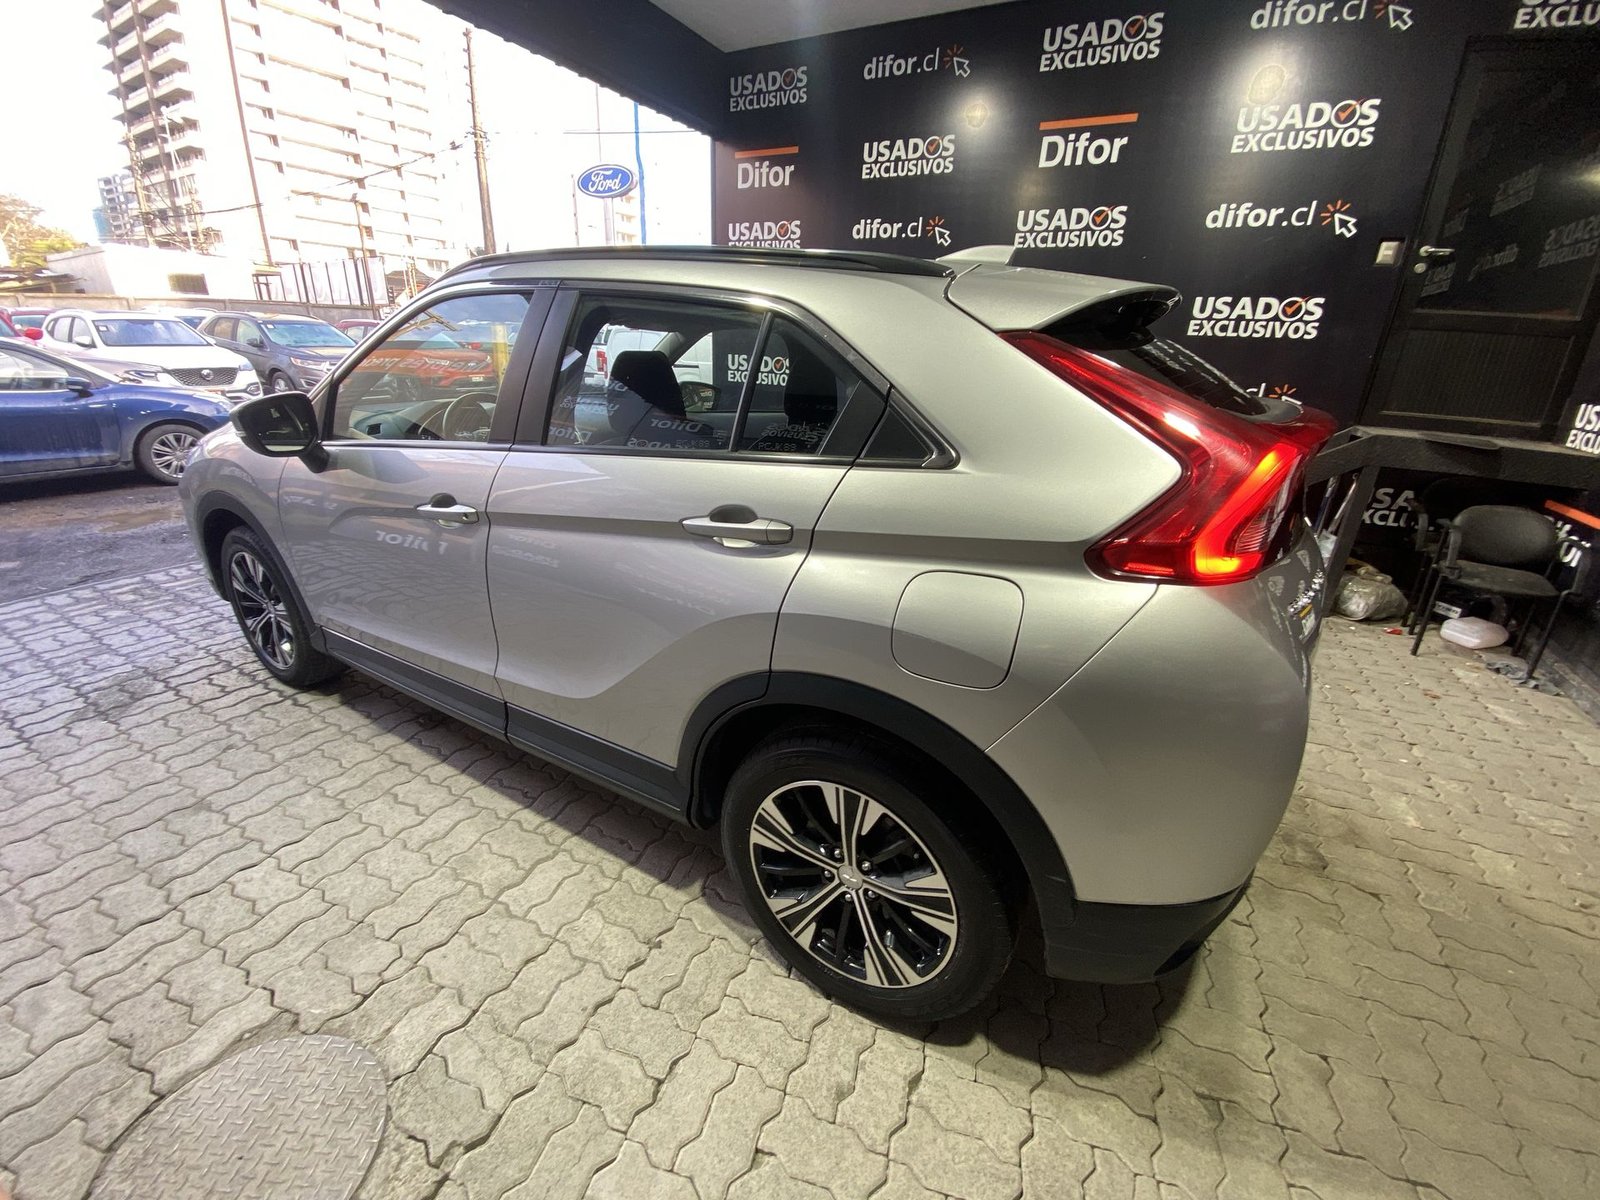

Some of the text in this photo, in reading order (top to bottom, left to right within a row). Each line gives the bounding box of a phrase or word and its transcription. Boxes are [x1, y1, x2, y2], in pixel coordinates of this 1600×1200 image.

[1250, 0, 1367, 30] difor.cl
[1043, 12, 1165, 52] USADOS
[863, 47, 940, 80] difor.cl
[1039, 39, 1161, 72] EXCLUSIVOS
[730, 65, 807, 96] USADOS
[729, 87, 807, 112] EXCLUSIVOS
[1236, 98, 1382, 133] USADOS
[863, 134, 955, 163] USADOS
[1038, 132, 1129, 168] Difor
[1230, 126, 1375, 153] EXCLUSIVOS
[589, 170, 622, 193] Ford
[737, 161, 795, 189] Difor
[862, 156, 954, 180] EXCLUSIVOS
[852, 216, 923, 240] difor.cl
[1016, 205, 1128, 233] USADOS
[1205, 200, 1318, 229] difor.cl
[728, 220, 801, 241] USADOS
[1014, 229, 1124, 250] EXCLUSIVOS
[1192, 296, 1325, 322] USADOS
[1187, 320, 1320, 339] EXCLUSIVOS
[728, 354, 790, 374] USDO
